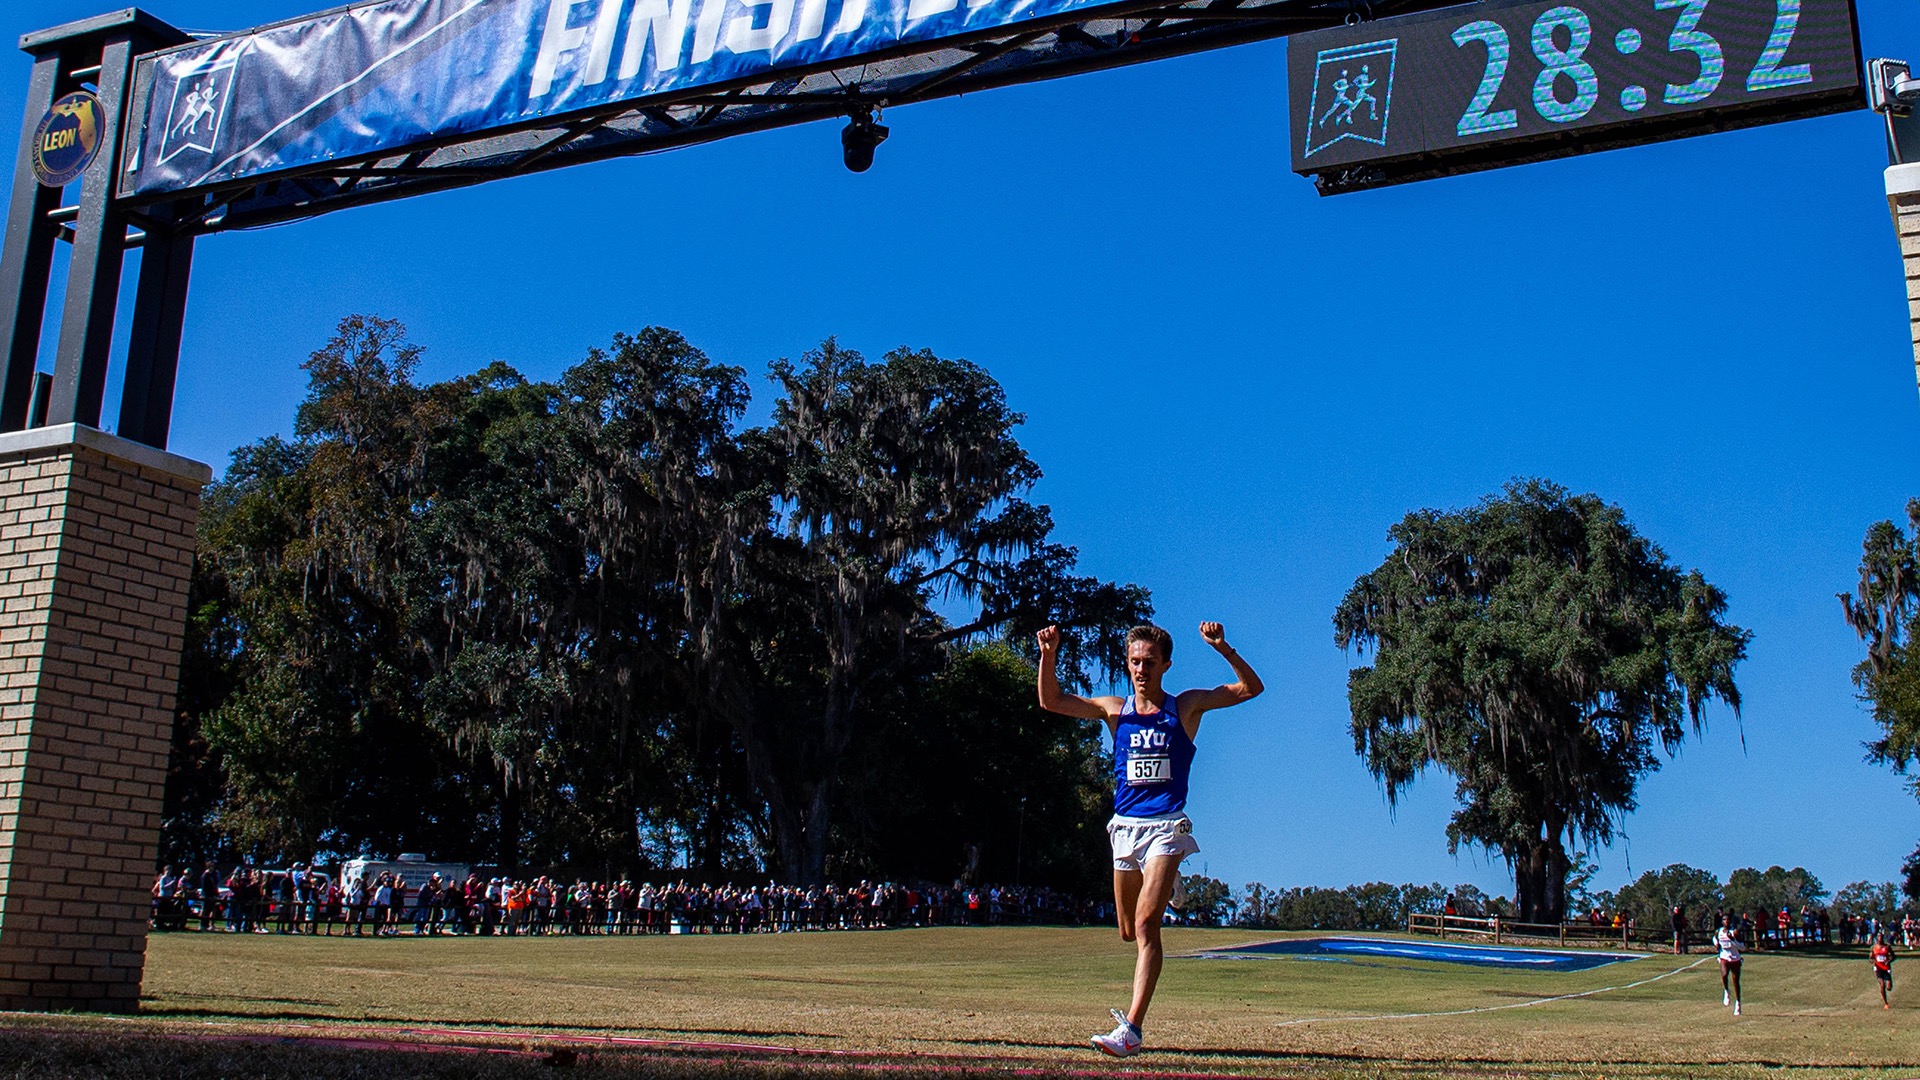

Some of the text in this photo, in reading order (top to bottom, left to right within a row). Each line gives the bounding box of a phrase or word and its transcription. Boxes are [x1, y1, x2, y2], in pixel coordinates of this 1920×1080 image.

[1451, 0, 1813, 136] 28:32
[43, 127, 77, 152] LEON
[1130, 728, 1166, 749] BYU
[1135, 760, 1162, 778] 557
